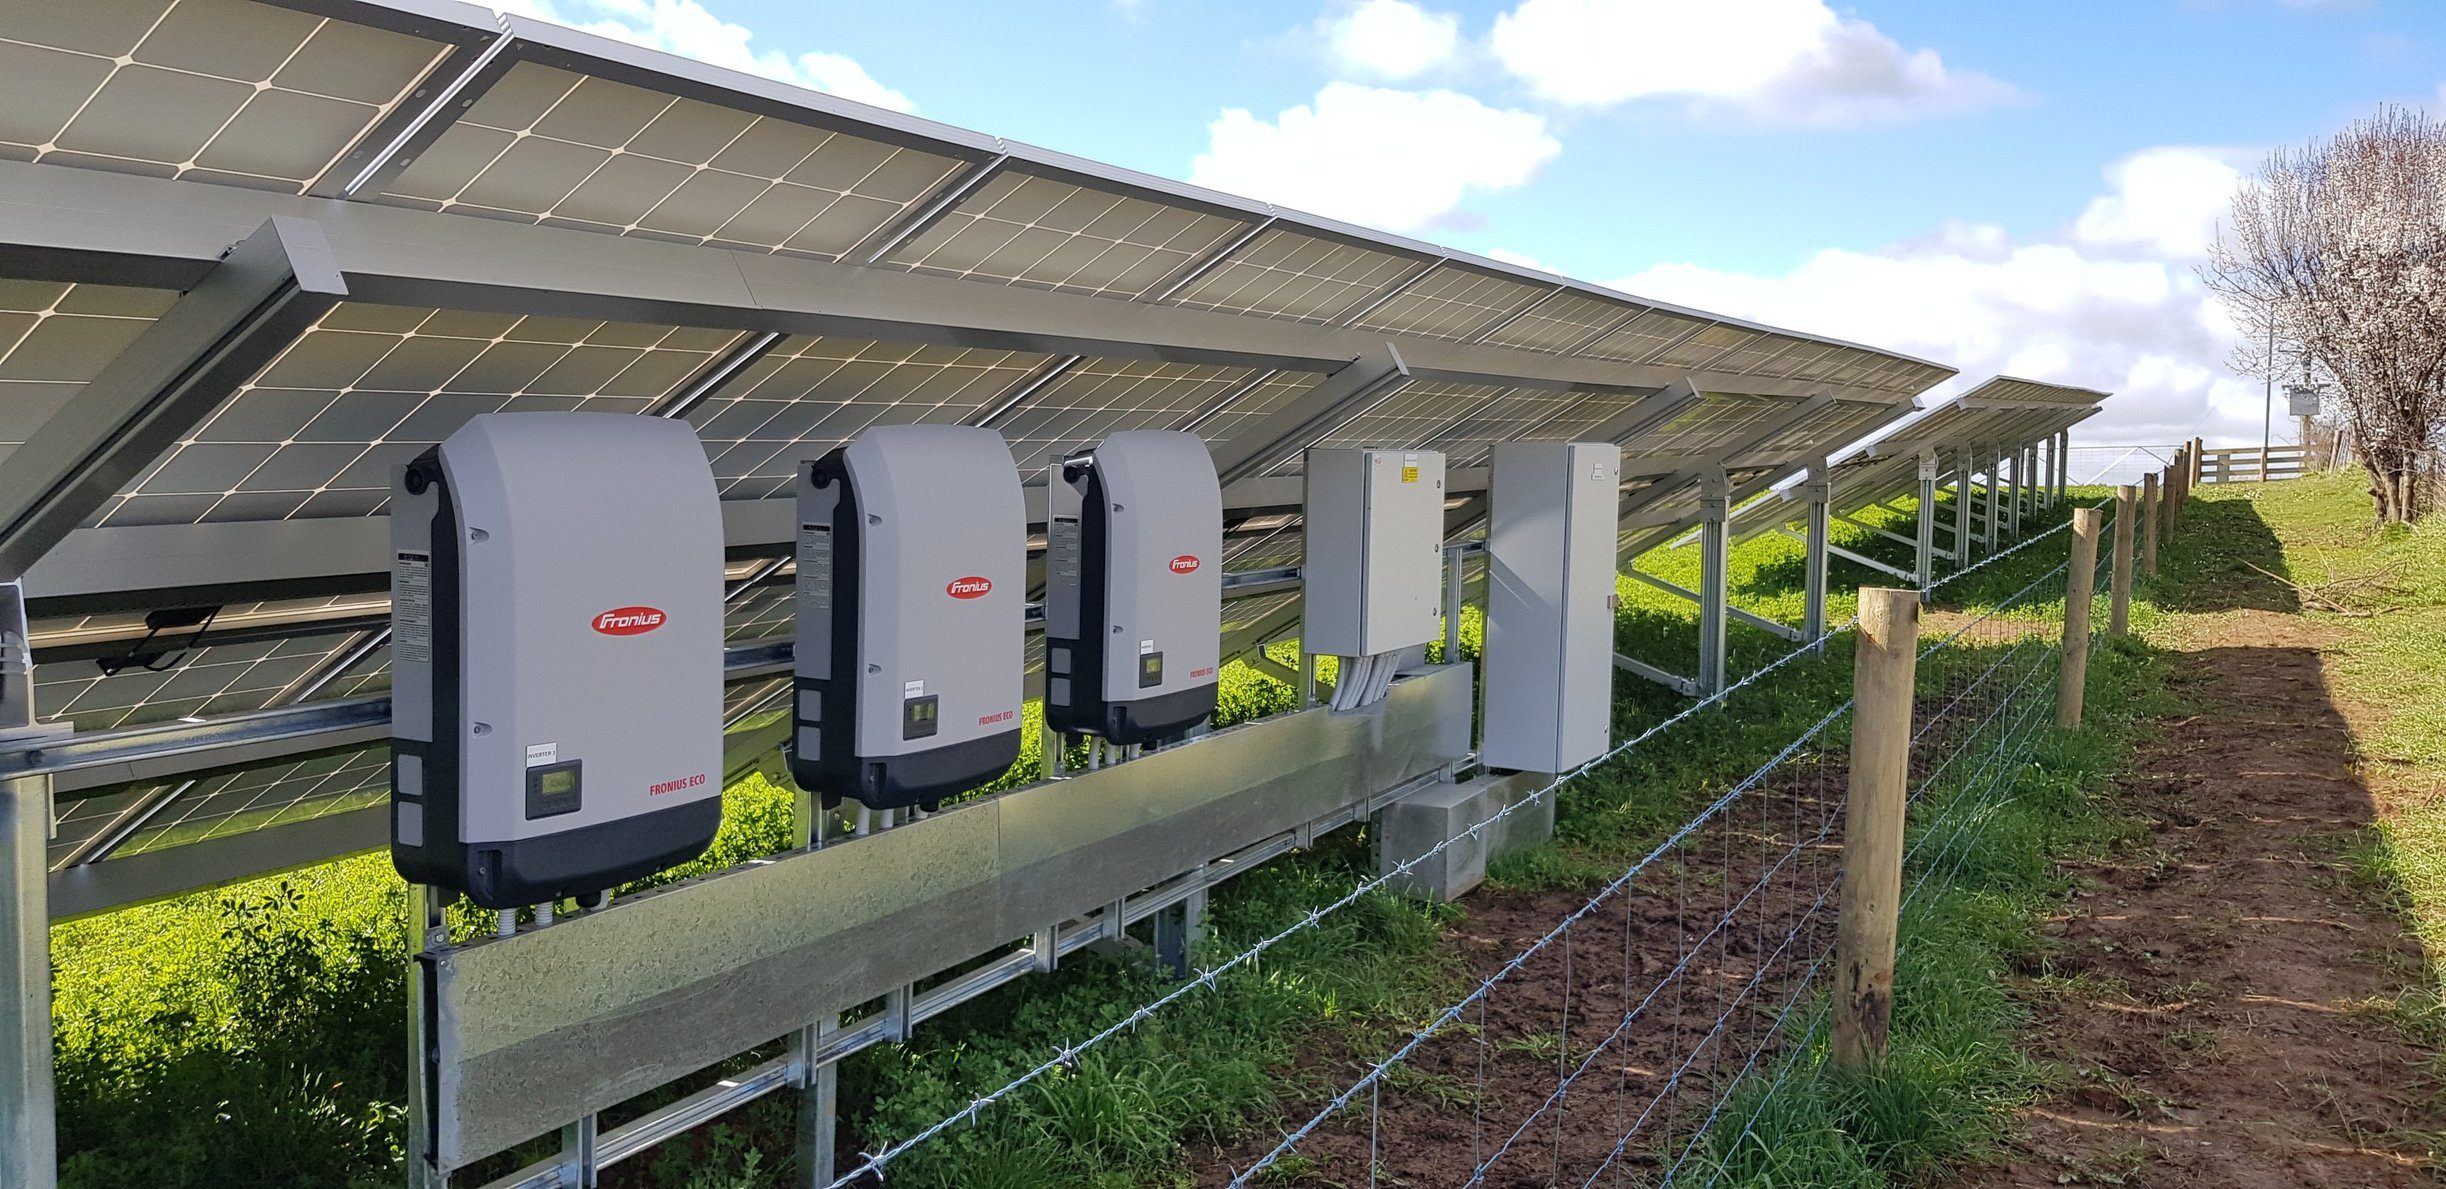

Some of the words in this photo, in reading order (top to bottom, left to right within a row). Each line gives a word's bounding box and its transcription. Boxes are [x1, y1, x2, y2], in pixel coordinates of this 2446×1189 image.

[1172, 560, 1198, 570] Fronius
[951, 581, 989, 594] Fronius
[599, 612, 661, 629] Fronius
[979, 713, 1002, 726] FRONIUS
[1003, 710, 1014, 720] ECO
[528, 751, 551, 759] INVERTER
[650, 778, 687, 796] FRONIUS
[689, 773, 706, 787] ECO
